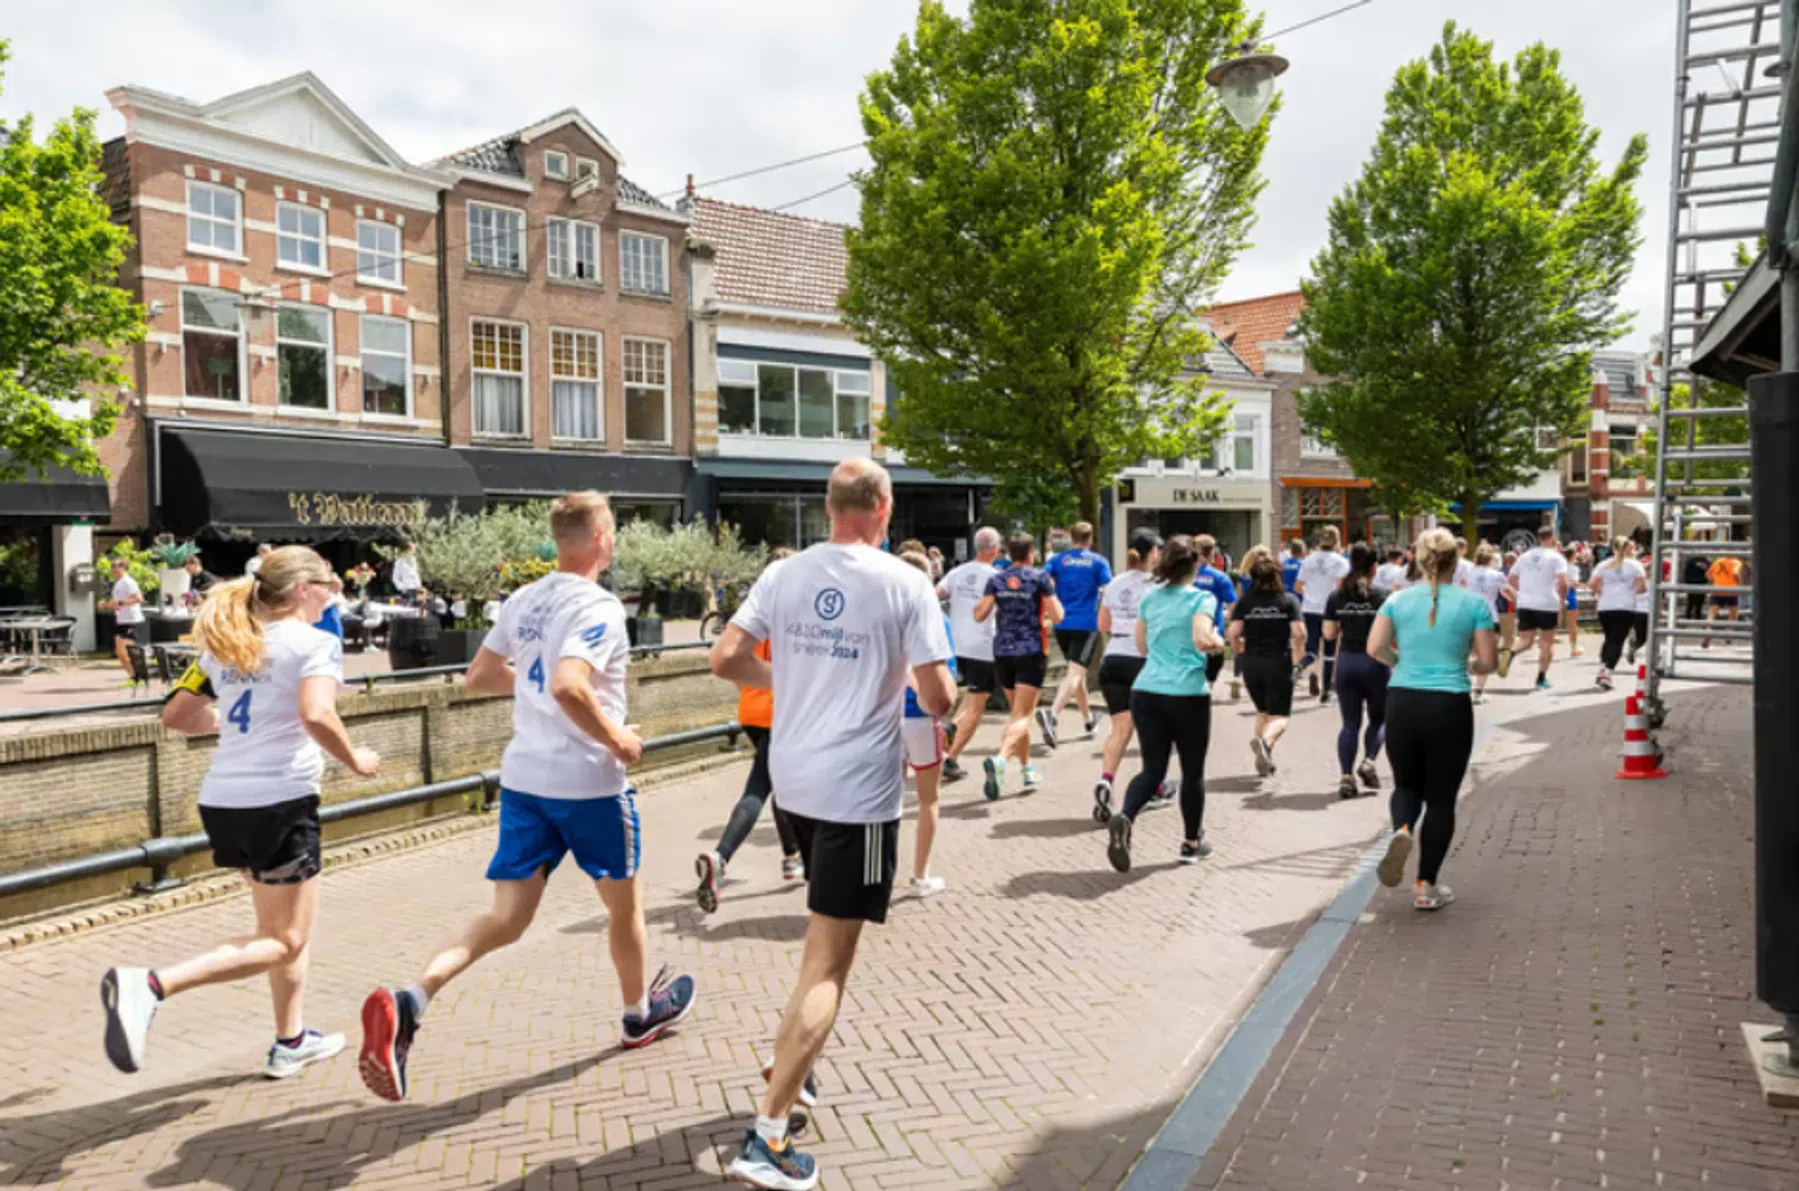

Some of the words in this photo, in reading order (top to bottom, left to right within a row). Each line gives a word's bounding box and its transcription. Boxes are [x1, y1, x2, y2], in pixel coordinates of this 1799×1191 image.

[1173, 488, 1187, 502] DE
[528, 655, 545, 694] 4
[228, 687, 252, 734] 4
